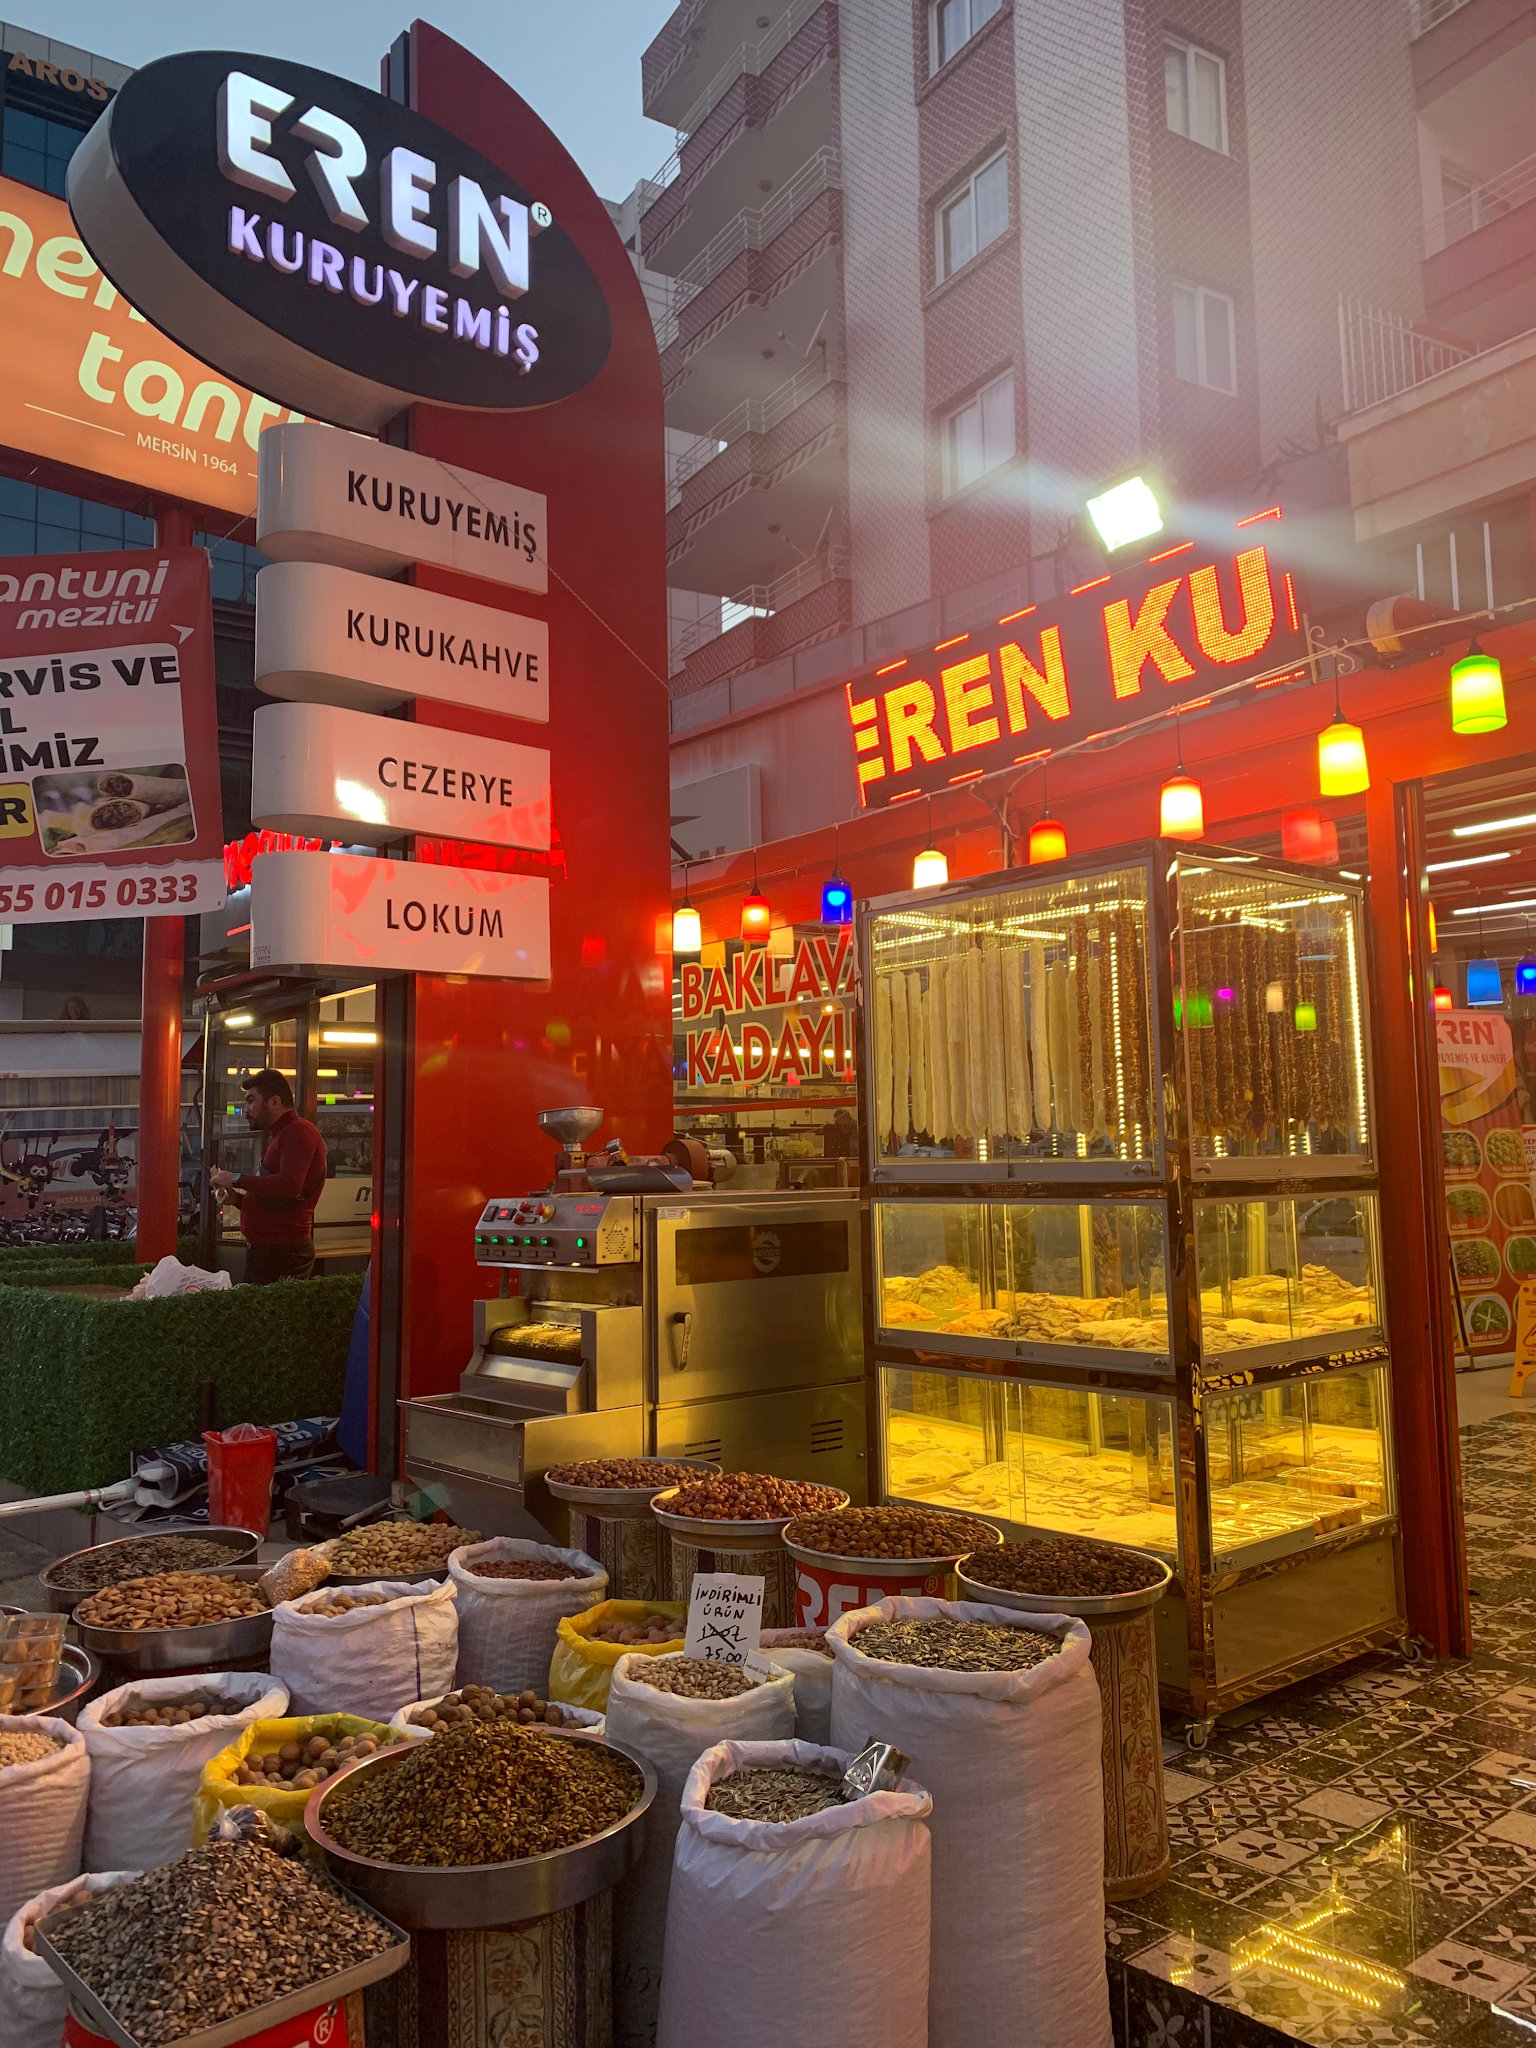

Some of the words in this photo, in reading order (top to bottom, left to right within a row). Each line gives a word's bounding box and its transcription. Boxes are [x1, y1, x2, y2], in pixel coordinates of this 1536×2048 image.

[8, 51, 108, 101] AROS
[217, 70, 530, 300] EREN
[228, 204, 541, 376] KURUYEMİŞ
[136, 431, 197, 464] MERSİN
[201, 452, 238, 477] 1964
[347, 469, 537, 563] KURUYEMİŞ
[16, 598, 159, 630] mezitli
[347, 608, 539, 683] KURUKAHVE
[1102, 546, 1276, 700] KU
[111, 655, 181, 686] VE
[378, 756, 513, 808] CEZERYE
[44, 880, 107, 910] 015
[116, 874, 199, 907] 0333
[681, 931, 856, 1022] BAKLAV
